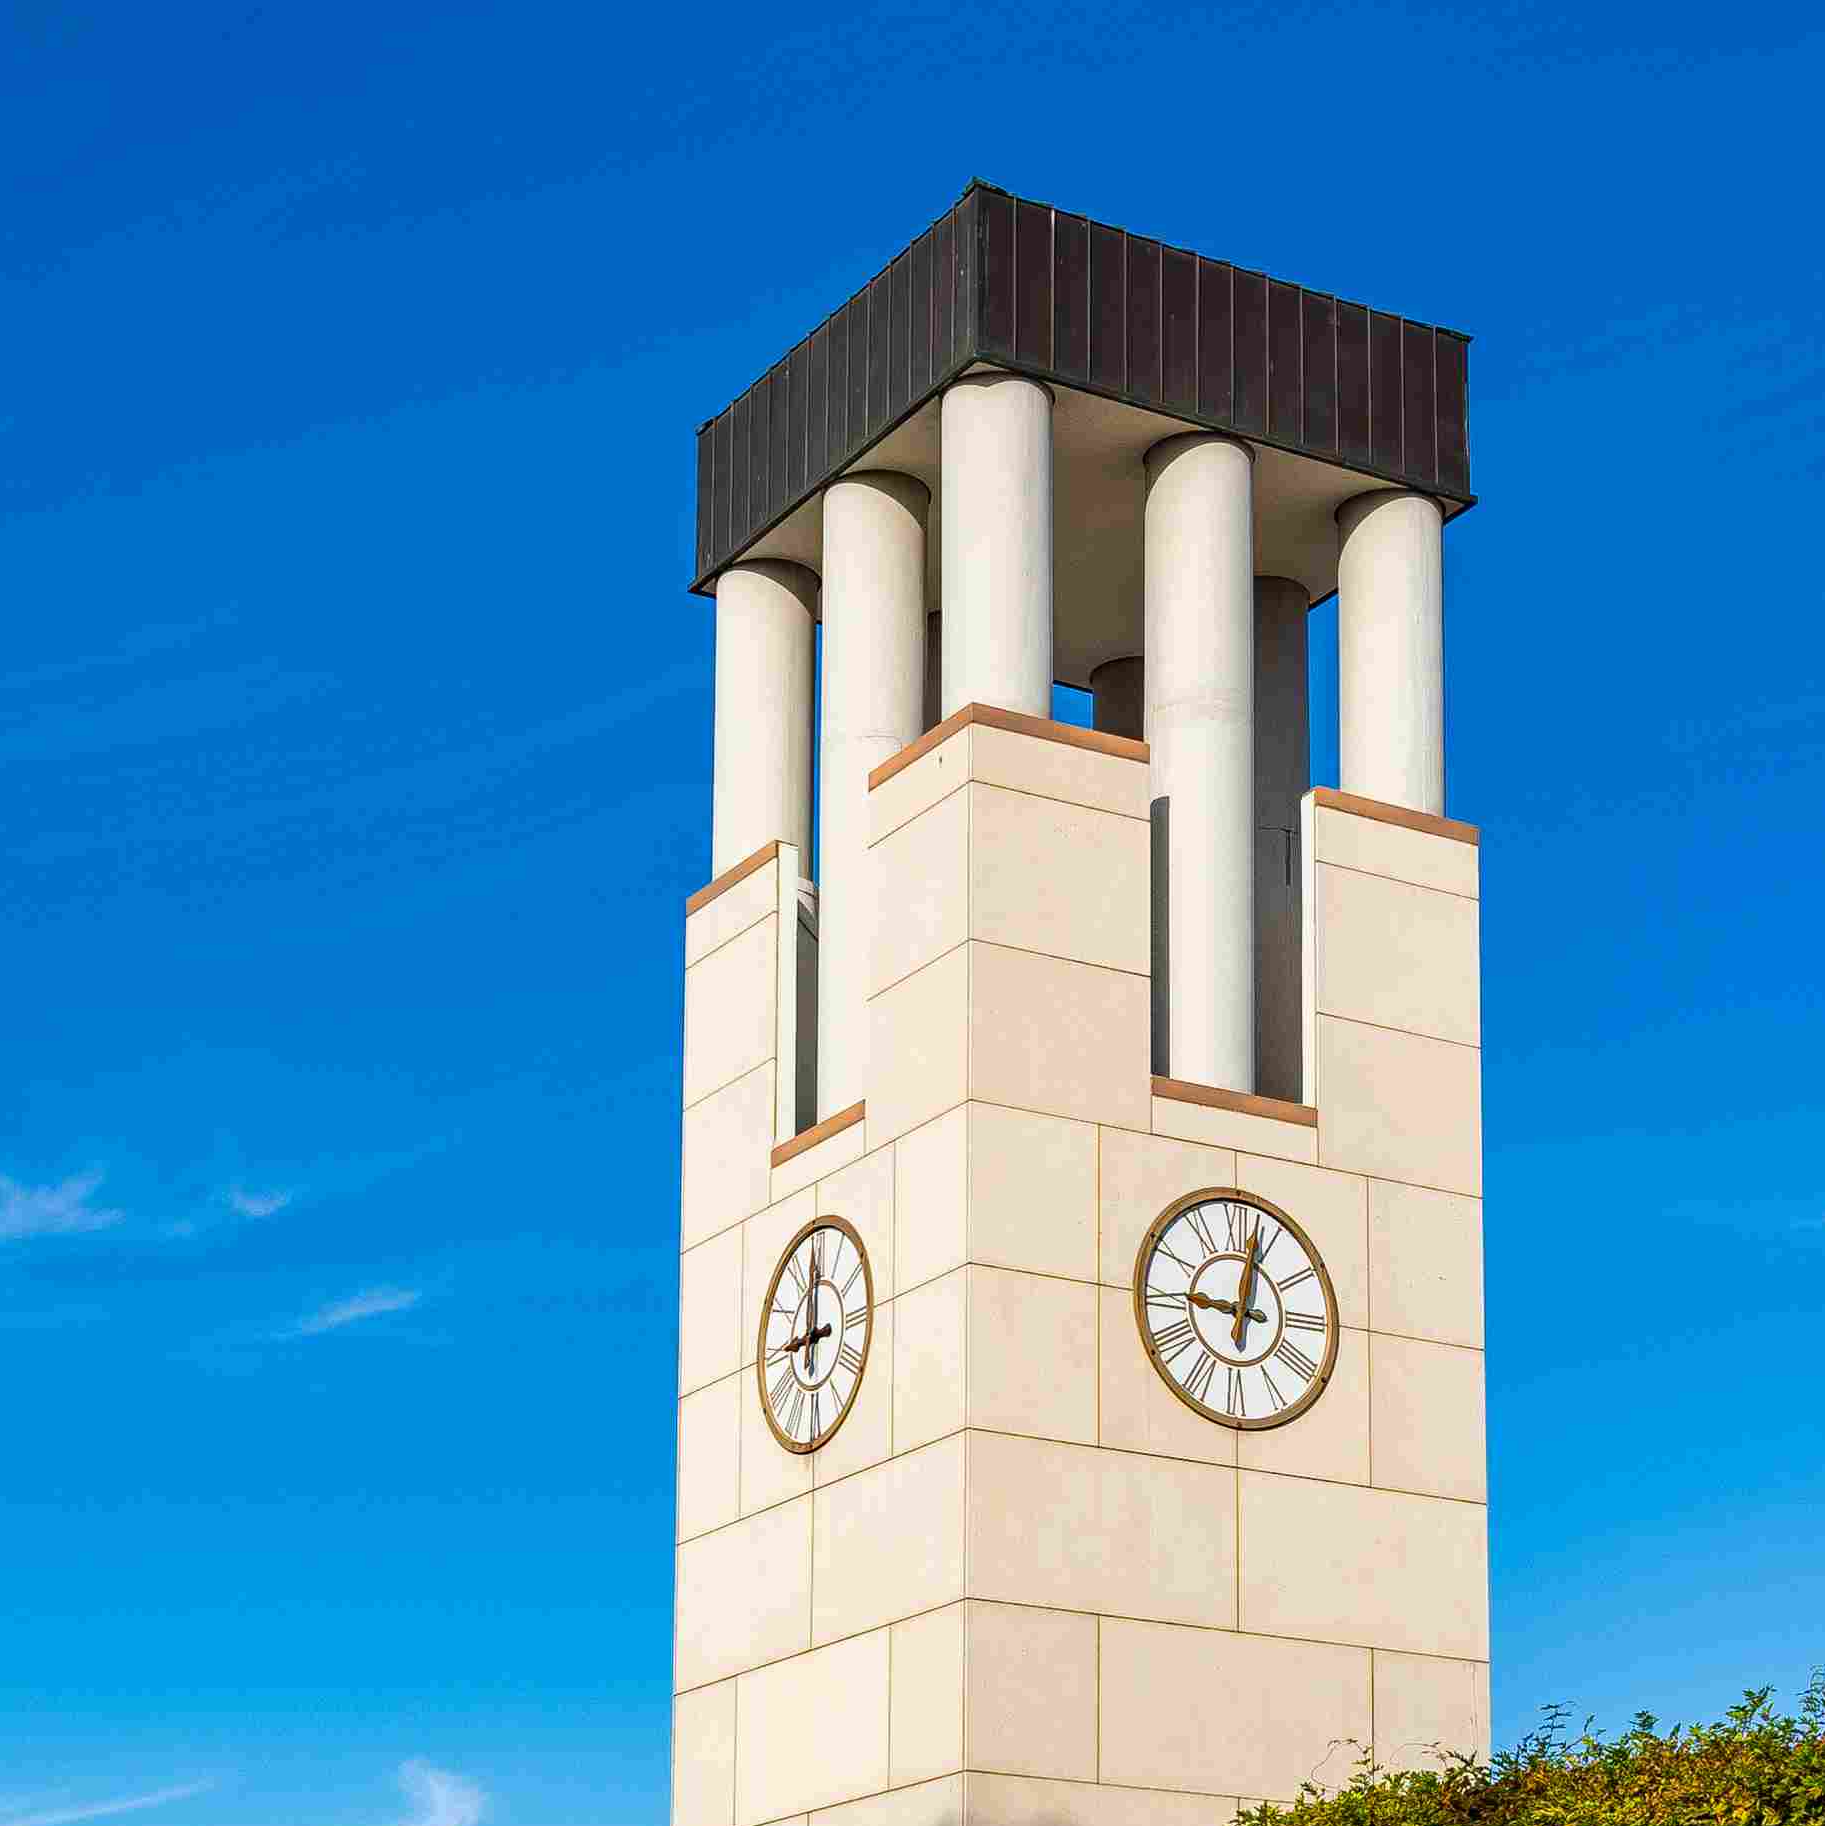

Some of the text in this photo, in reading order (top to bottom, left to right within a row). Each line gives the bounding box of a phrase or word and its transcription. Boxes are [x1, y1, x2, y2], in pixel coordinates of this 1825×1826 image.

[1183, 1207, 1218, 1258] XI
[1224, 1203, 1248, 1253] XII
[1259, 1226, 1283, 1264] I
[1156, 1239, 1196, 1278] X
[1276, 1266, 1316, 1293] II
[1145, 1284, 1188, 1310] IX
[1152, 1318, 1197, 1365] VIII
[1285, 1311, 1325, 1334] III
[1182, 1350, 1217, 1402] VII
[1274, 1338, 1319, 1384] IIII
[1226, 1367, 1247, 1416] VI
[1260, 1364, 1288, 1411] V
